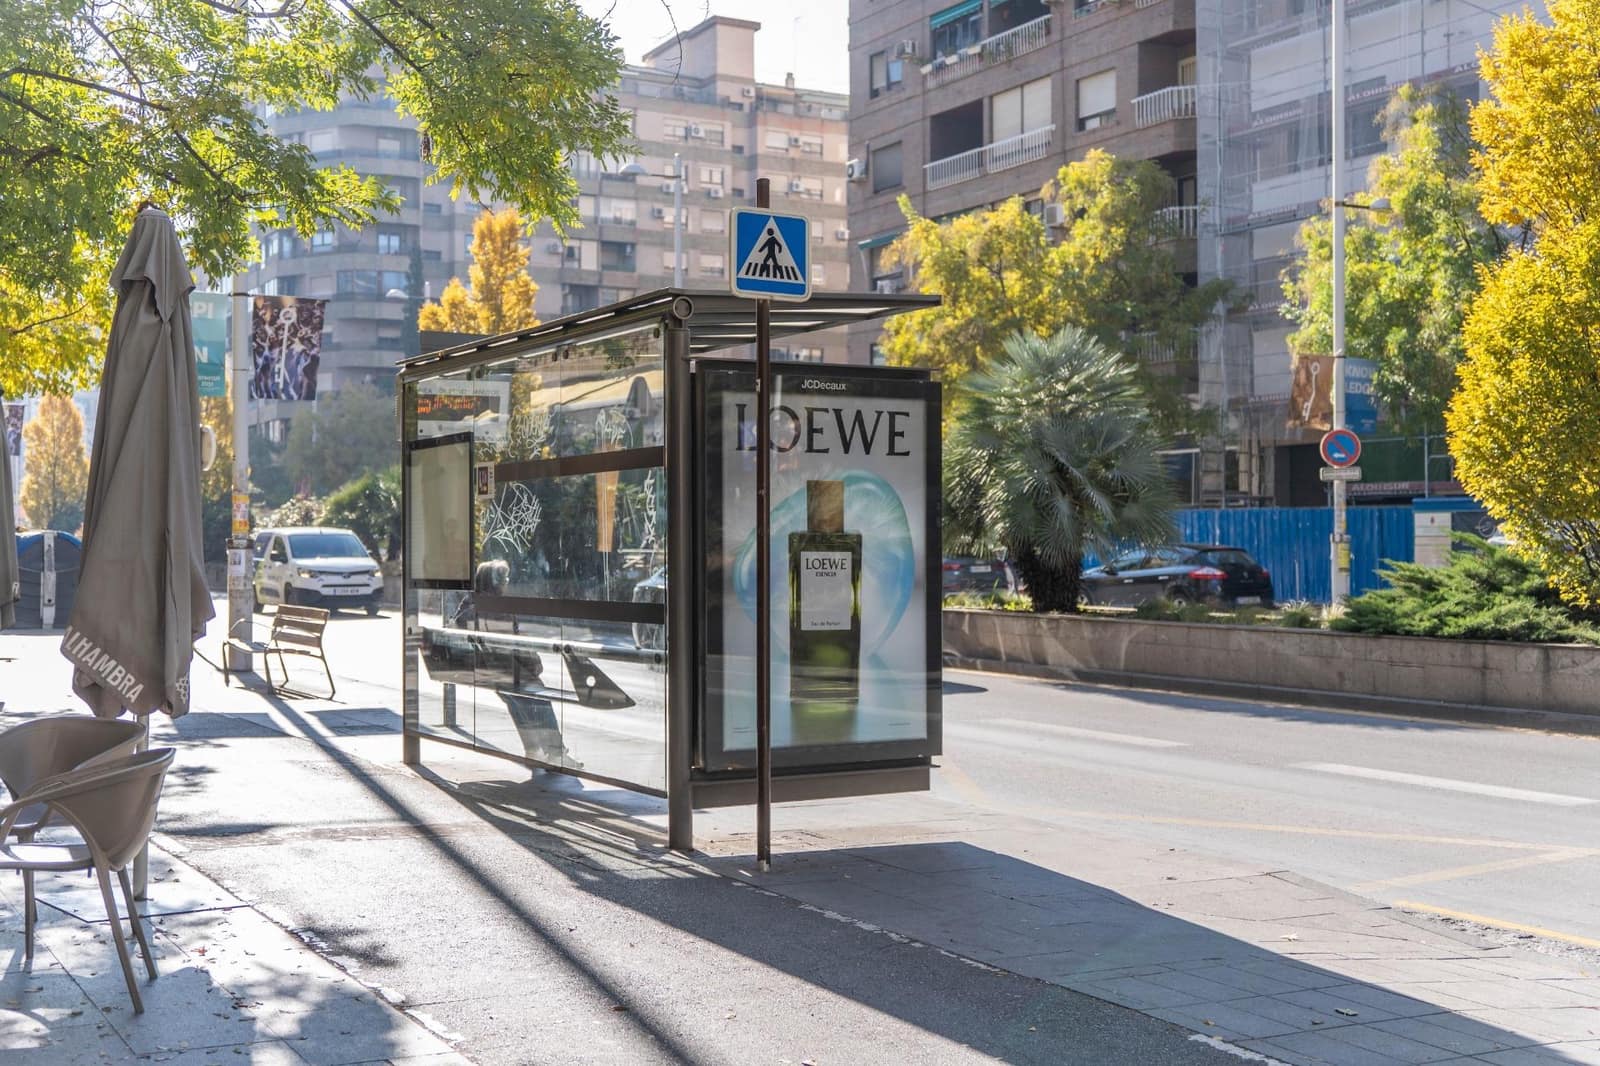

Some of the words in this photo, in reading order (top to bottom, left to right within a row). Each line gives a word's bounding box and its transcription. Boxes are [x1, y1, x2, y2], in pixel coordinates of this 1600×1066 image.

[801, 379, 847, 391] JCDecaux
[735, 403, 911, 457] LOEWE
[805, 558, 847, 570] LOEWE
